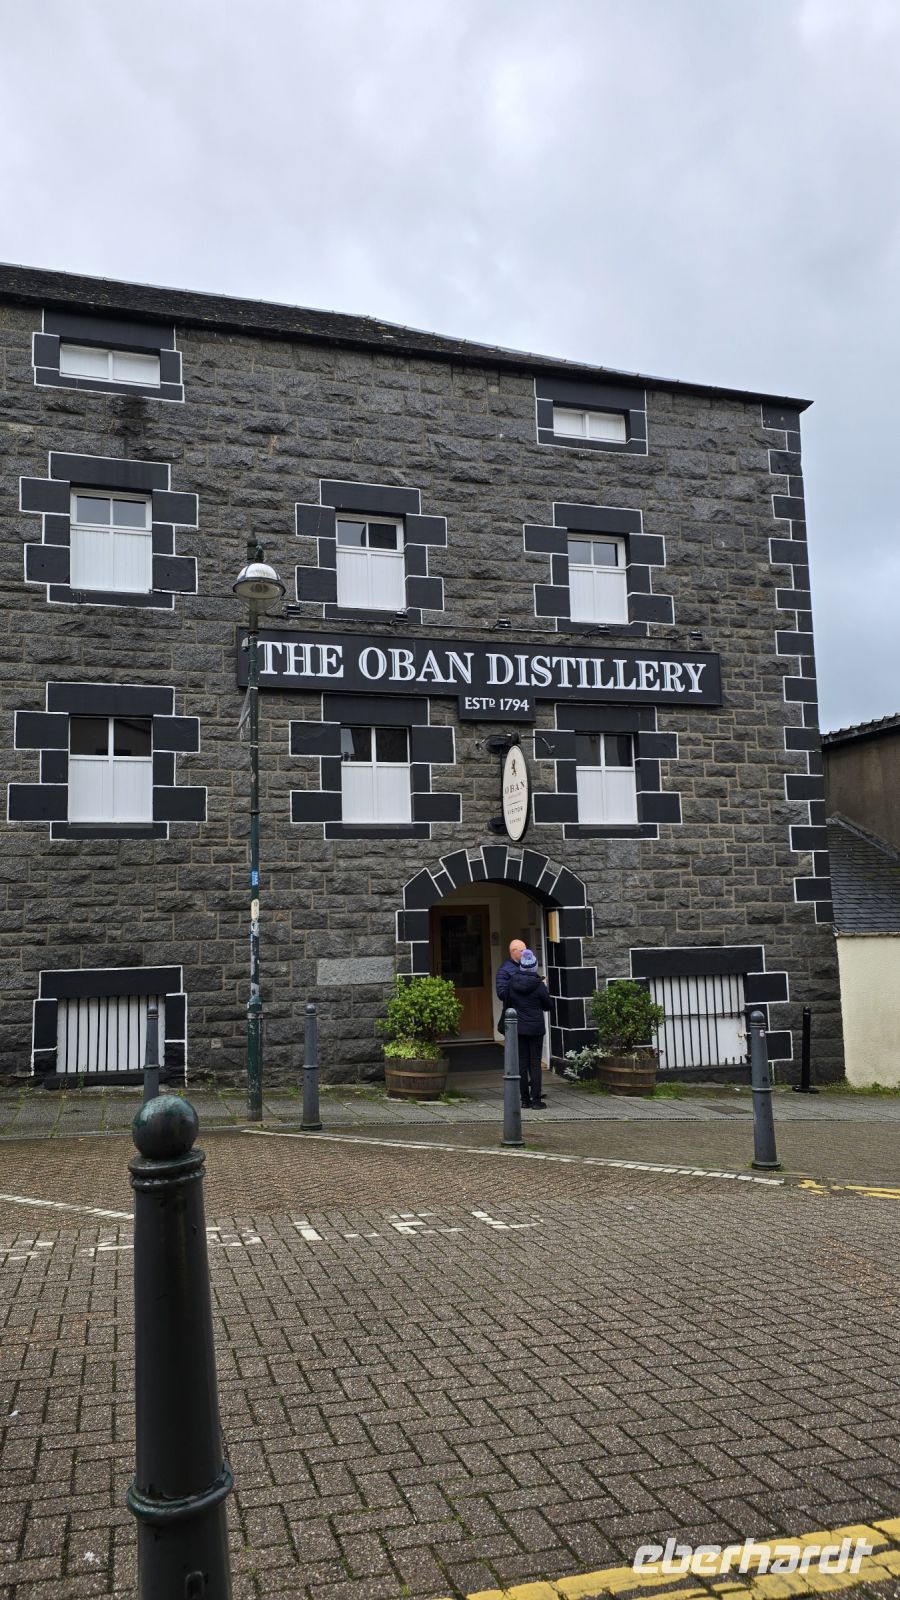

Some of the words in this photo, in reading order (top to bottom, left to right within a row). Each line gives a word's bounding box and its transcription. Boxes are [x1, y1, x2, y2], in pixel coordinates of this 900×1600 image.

[257, 640, 345, 679] THE
[358, 646, 475, 684] OBAN
[486, 653, 707, 694] DISTILLERY
[499, 698, 530, 712] 1794
[504, 780, 525, 793] OBAN
